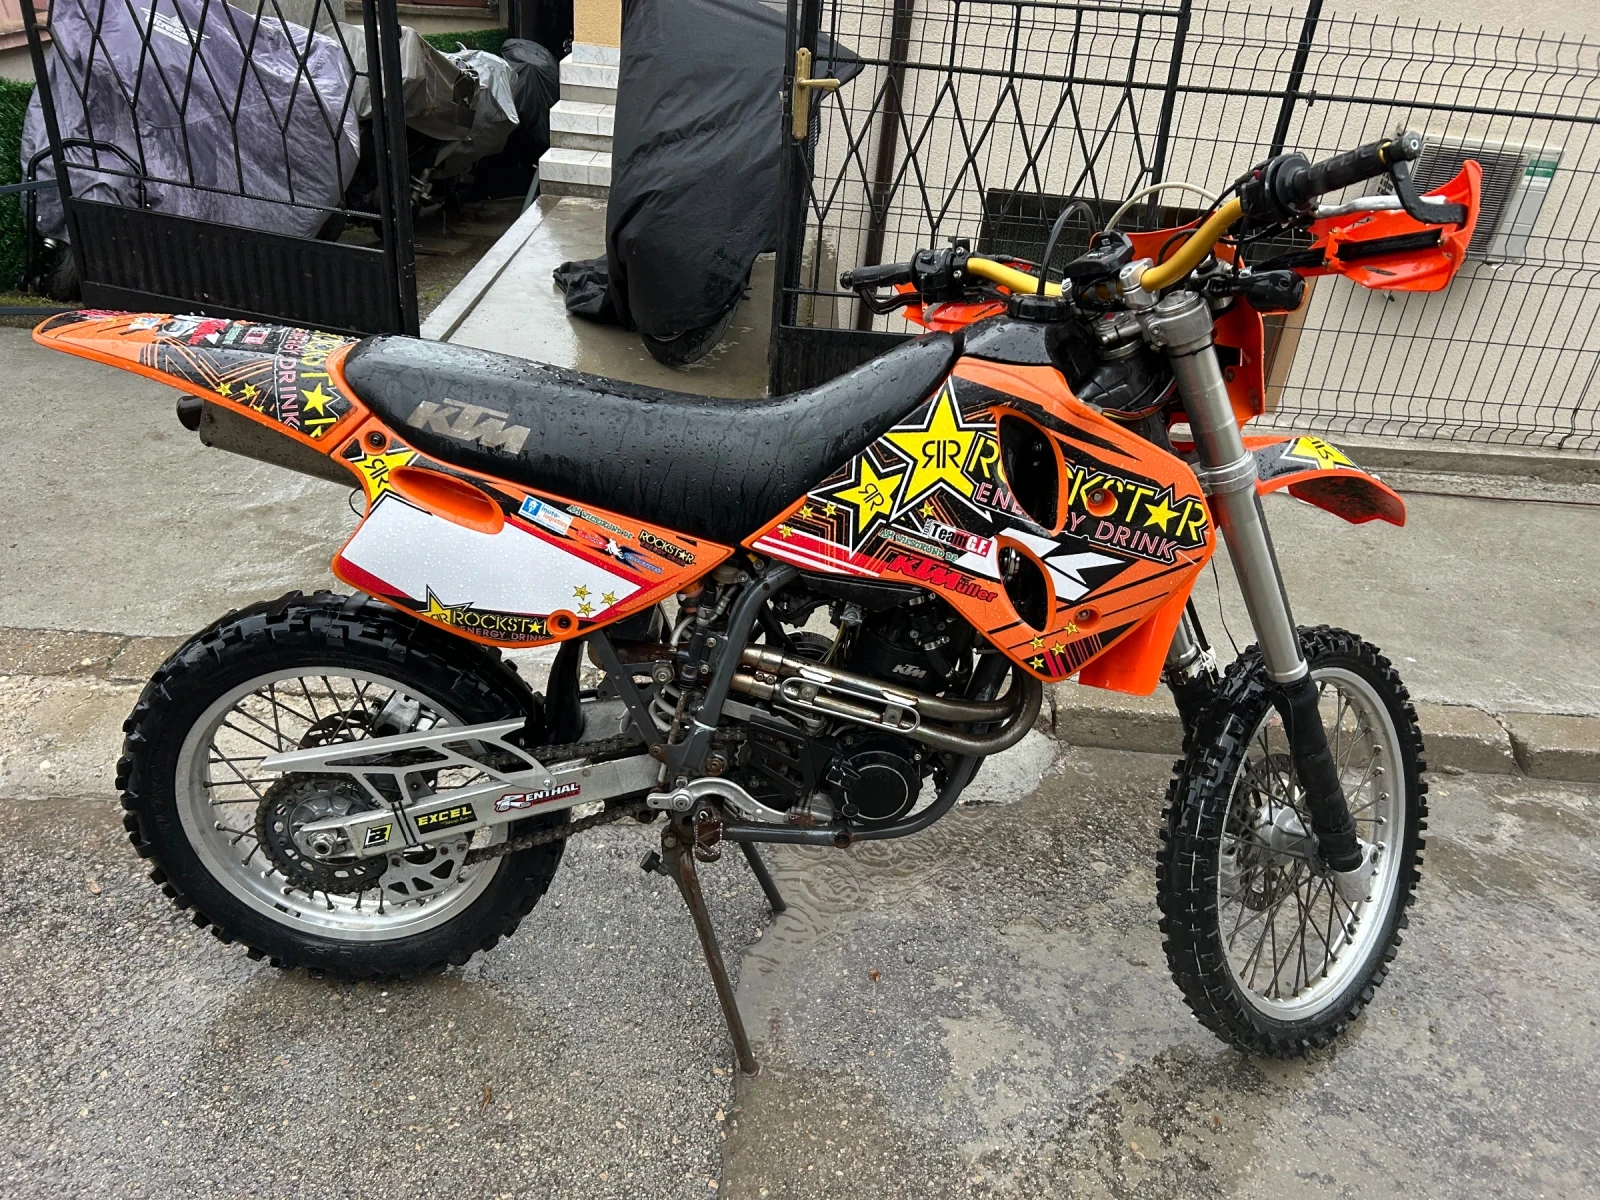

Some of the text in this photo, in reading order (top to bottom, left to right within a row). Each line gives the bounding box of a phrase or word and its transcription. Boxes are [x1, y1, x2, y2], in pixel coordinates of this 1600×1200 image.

[407, 398, 531, 455] KTM
[1094, 520, 1178, 559] DRINK
[892, 663, 928, 679] KTM
[417, 806, 472, 826] EXCEL
